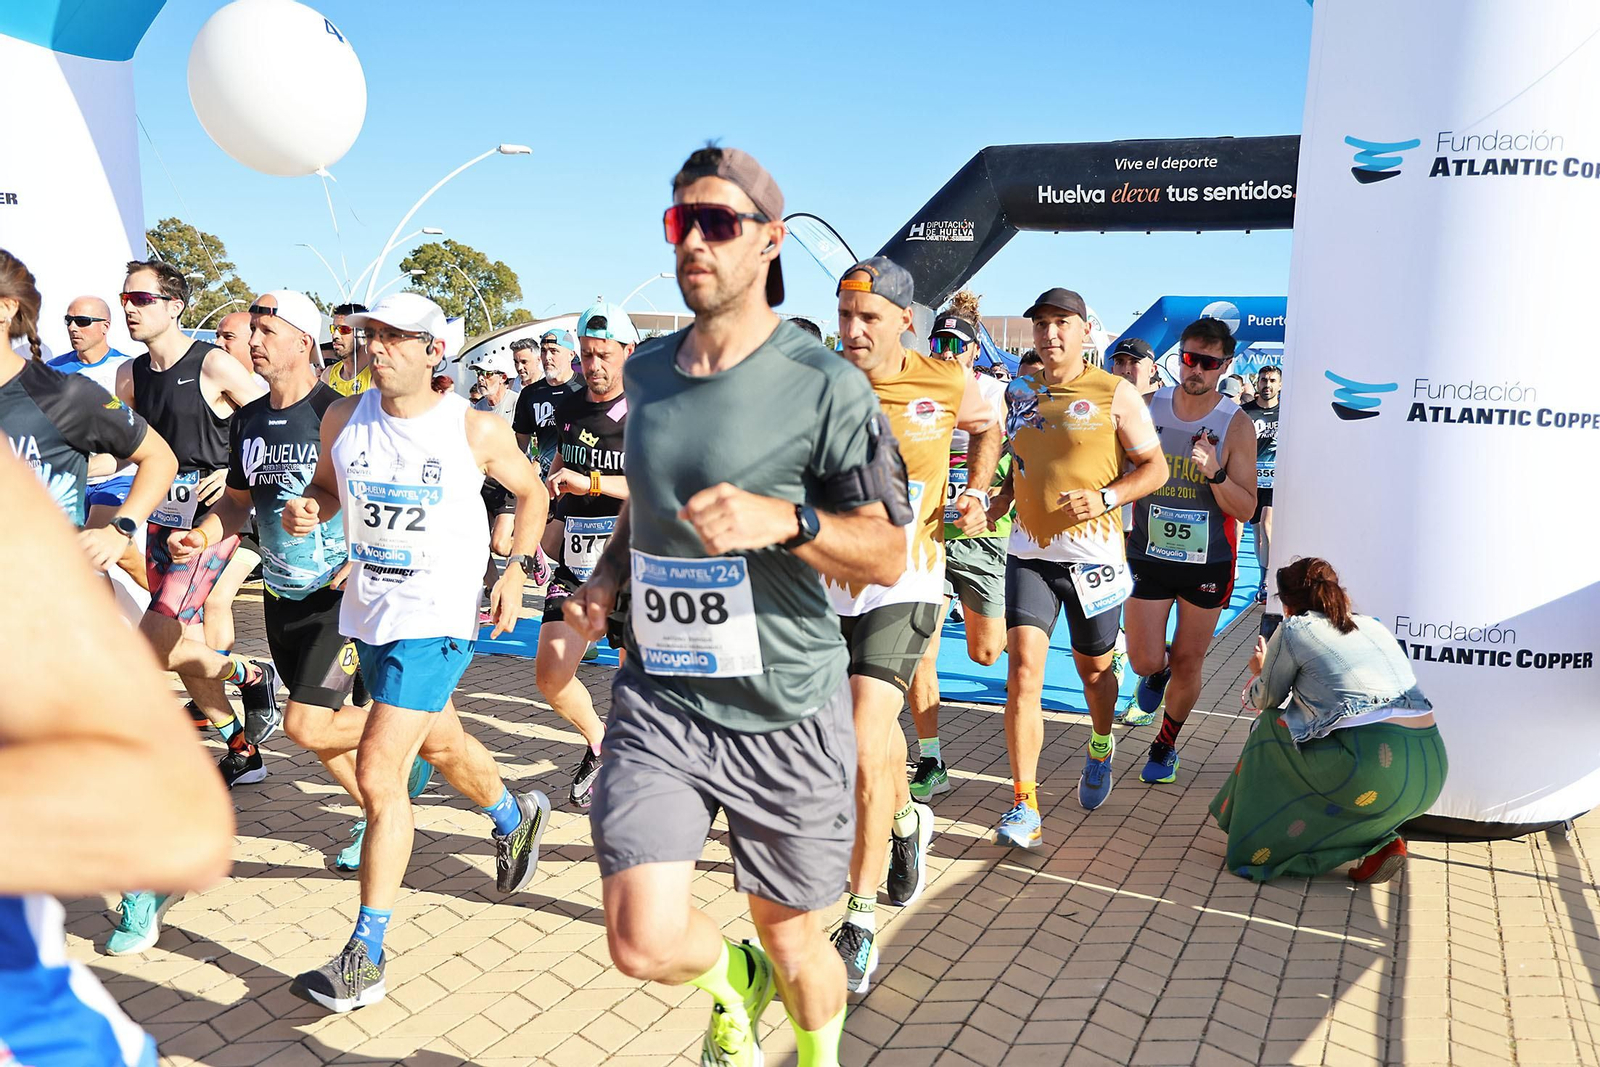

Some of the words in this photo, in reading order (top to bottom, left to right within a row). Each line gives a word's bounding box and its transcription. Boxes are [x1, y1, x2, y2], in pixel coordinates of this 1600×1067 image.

[1436, 130, 1564, 152] Fundación
[1114, 158, 1143, 170] Vive
[1146, 157, 1158, 170] el
[1161, 156, 1218, 172] deporte
[1429, 156, 1558, 177] ATLANTIC
[1038, 184, 1105, 204] Huelva
[1111, 182, 1160, 204] eleva
[1166, 184, 1198, 202] tus
[1203, 181, 1297, 201] sentidos.
[926, 218, 975, 229] DIPUTACIÓN
[926, 228, 937, 236] DE
[939, 228, 974, 236] HUELVA
[1413, 378, 1537, 402] Fundación
[1407, 402, 1532, 427] ATLANTIC
[264, 443, 319, 464] HUELVA
[1177, 486, 1197, 499] 2014
[364, 502, 426, 532] 372
[1164, 522, 1191, 540] 95
[365, 547, 405, 560] Wayalia
[1155, 547, 1183, 557] Wayalia
[645, 588, 729, 625] 908
[1395, 616, 1516, 644] Fundación
[648, 650, 709, 667] Wayalia
[1516, 649, 1593, 669] COPPER
